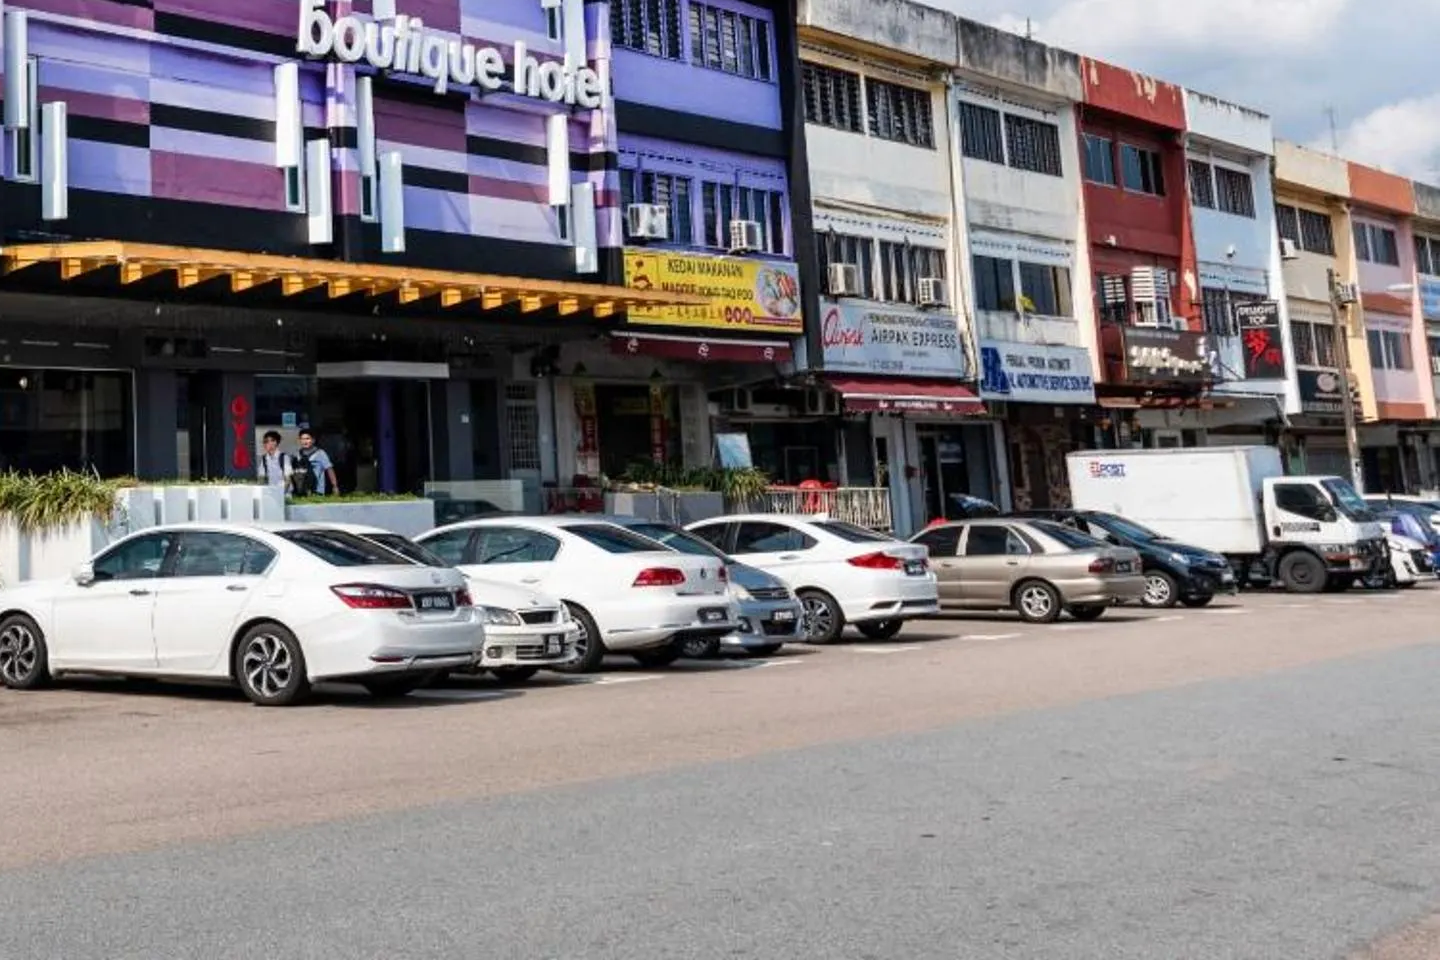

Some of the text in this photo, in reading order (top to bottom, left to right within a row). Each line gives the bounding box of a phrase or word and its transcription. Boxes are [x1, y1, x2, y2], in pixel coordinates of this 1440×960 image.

[297, 3, 610, 109] boutique hotel
[668, 258, 744, 278] KEDAI MAKANAN
[871, 327, 957, 350] AIRPAK EXPRESS
